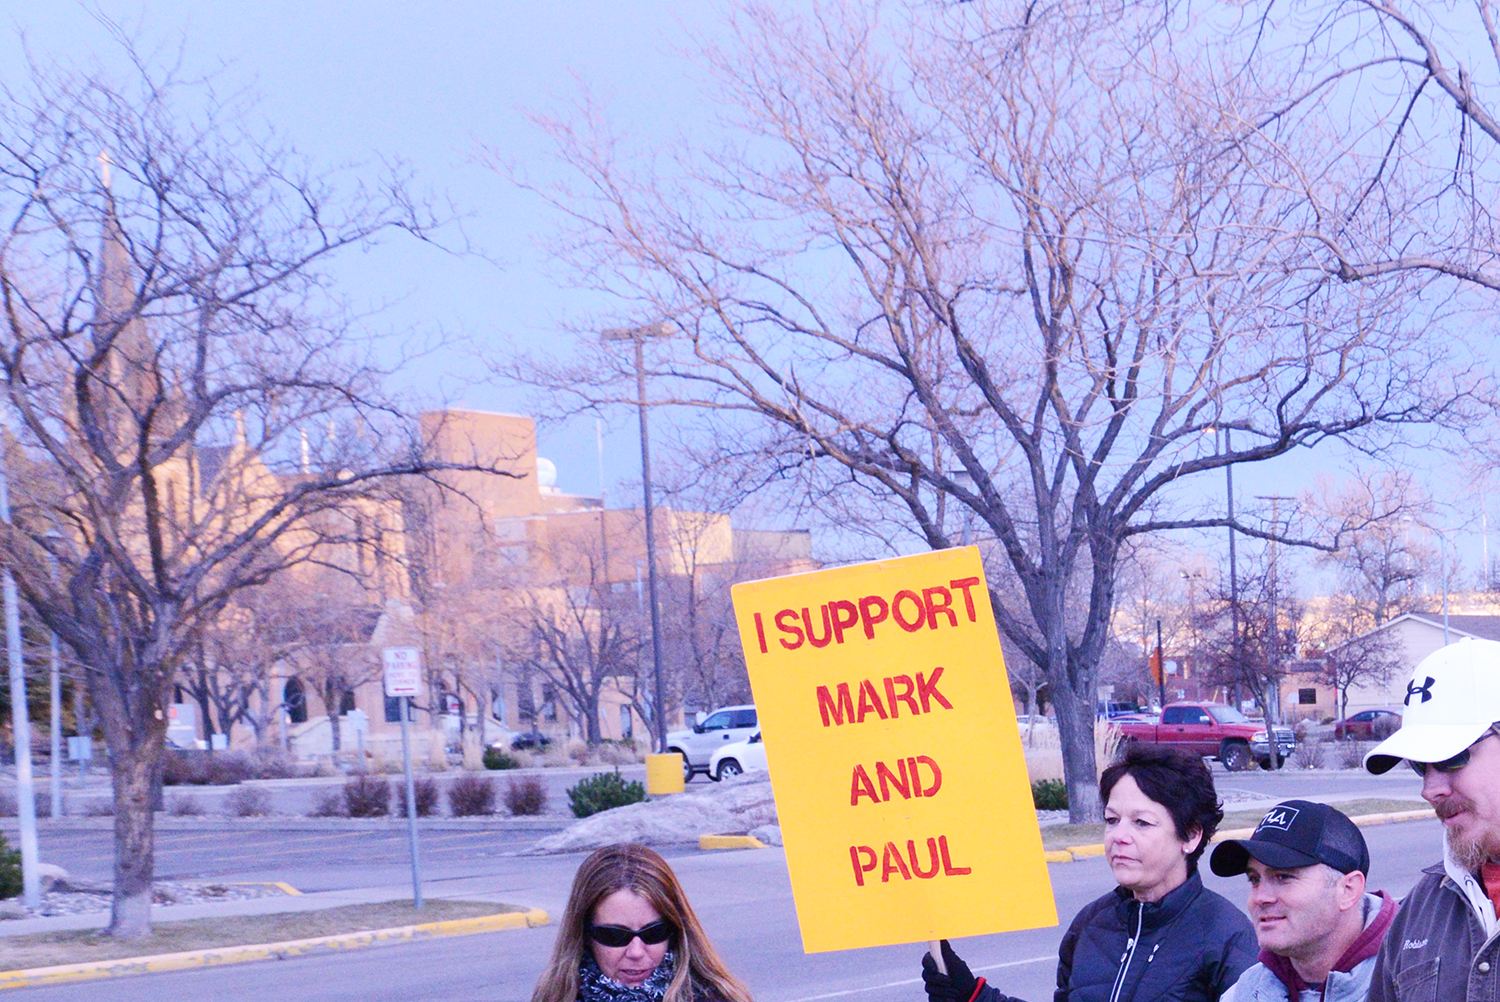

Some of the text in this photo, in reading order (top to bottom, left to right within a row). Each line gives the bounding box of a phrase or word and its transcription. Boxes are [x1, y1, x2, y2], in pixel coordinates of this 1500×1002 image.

[753, 576, 981, 653] I SUPPORT
[816, 667, 955, 728] MARK
[850, 755, 943, 806] AND
[849, 834, 972, 887] PAUL
